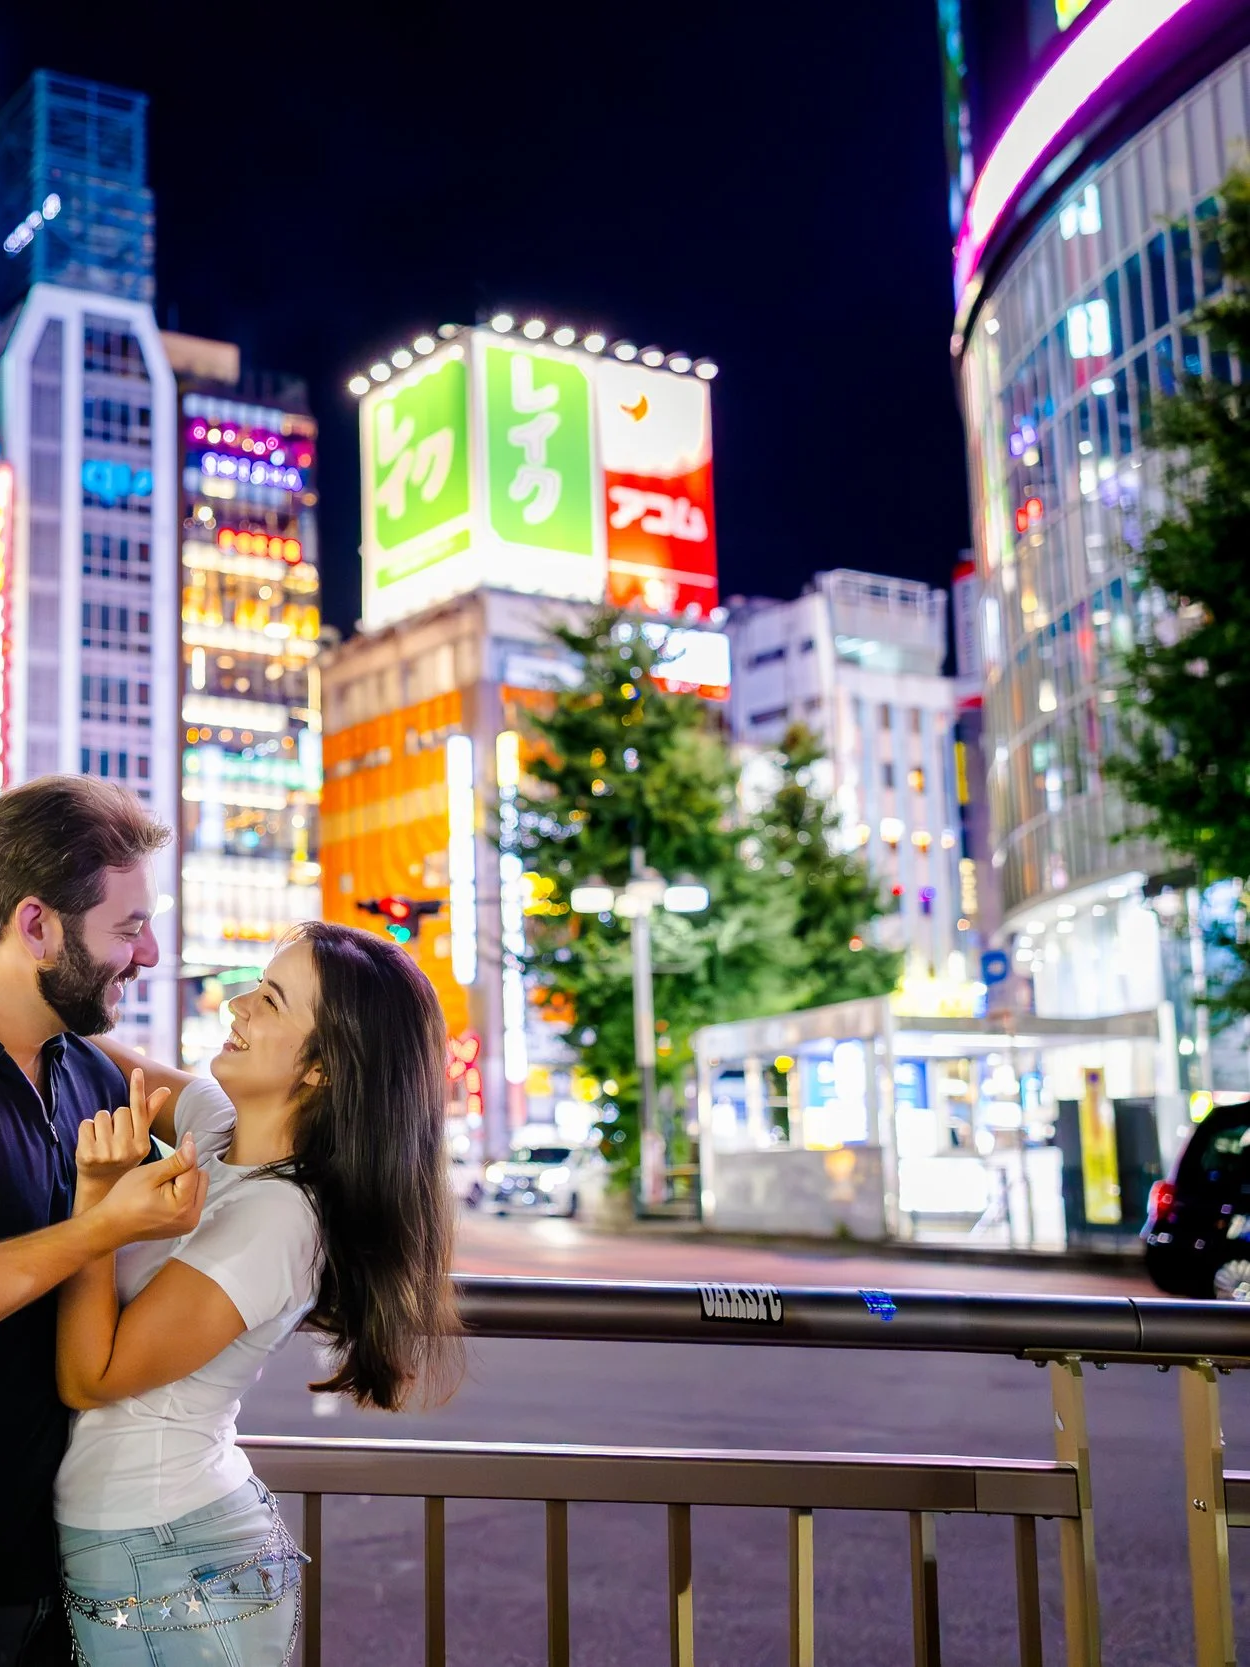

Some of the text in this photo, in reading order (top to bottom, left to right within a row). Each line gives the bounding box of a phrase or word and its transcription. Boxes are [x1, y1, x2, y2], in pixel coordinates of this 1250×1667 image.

[508, 354, 563, 525] レイク
[608, 484, 709, 542] アコム
